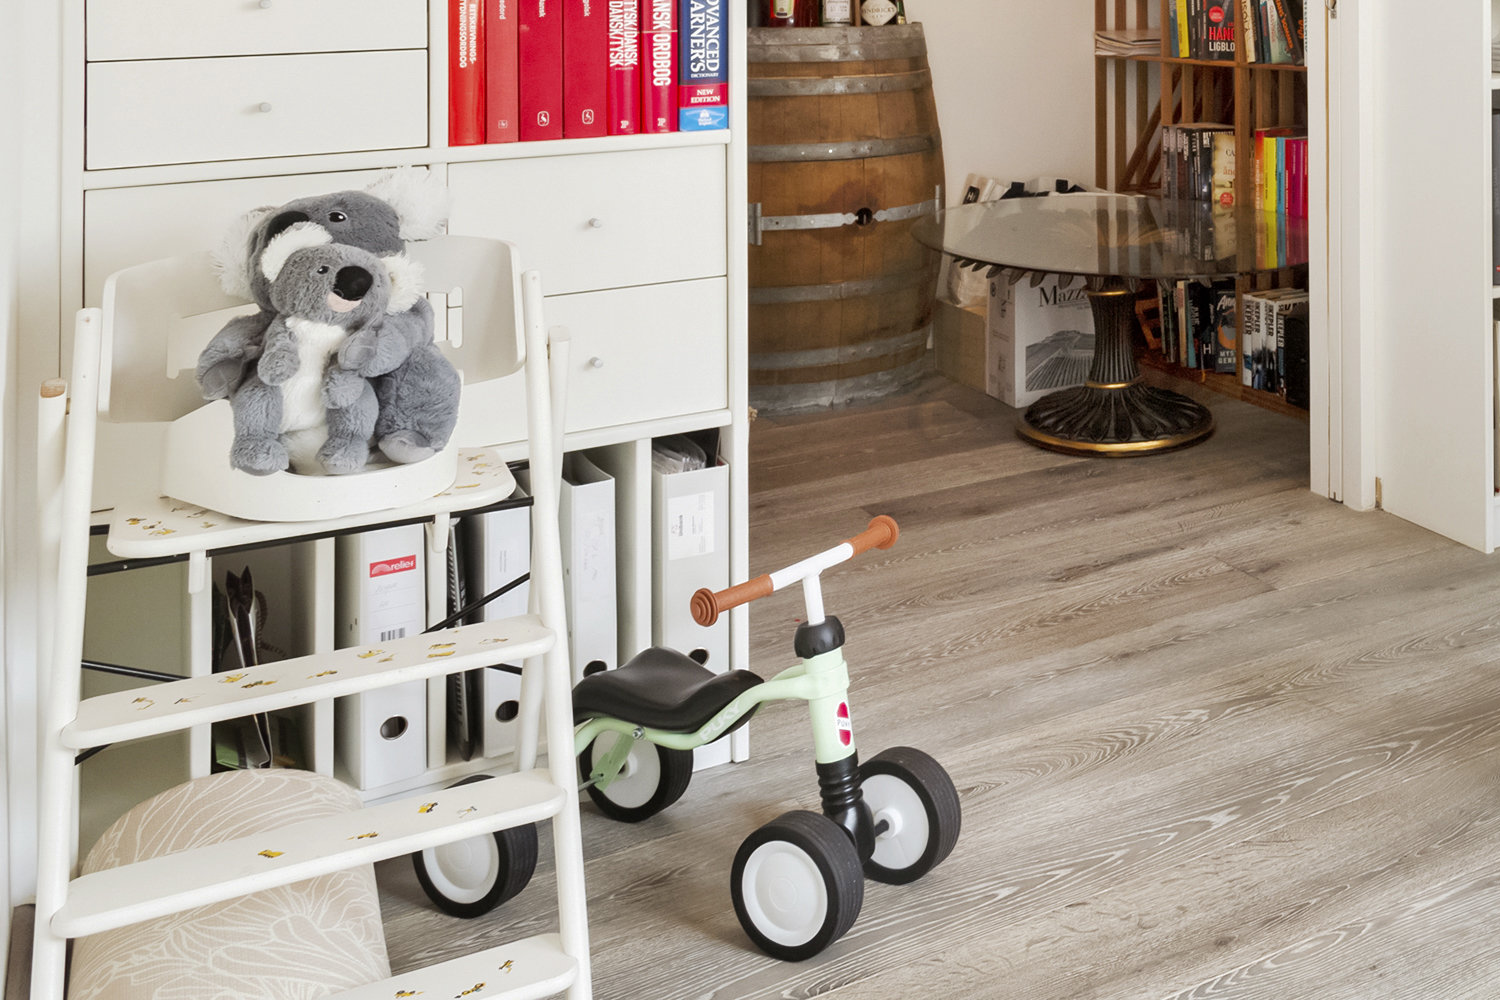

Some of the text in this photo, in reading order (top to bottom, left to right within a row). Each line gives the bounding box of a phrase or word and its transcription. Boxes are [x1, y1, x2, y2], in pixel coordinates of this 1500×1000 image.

[609, 1, 623, 67] DANSK/TYSK
[624, 0, 637, 65] TYSK/DANSK
[653, 34, 671, 86] ORDBOG
[1244, 304, 1252, 335] KEPLER
[700, 701, 740, 741] PUKY
